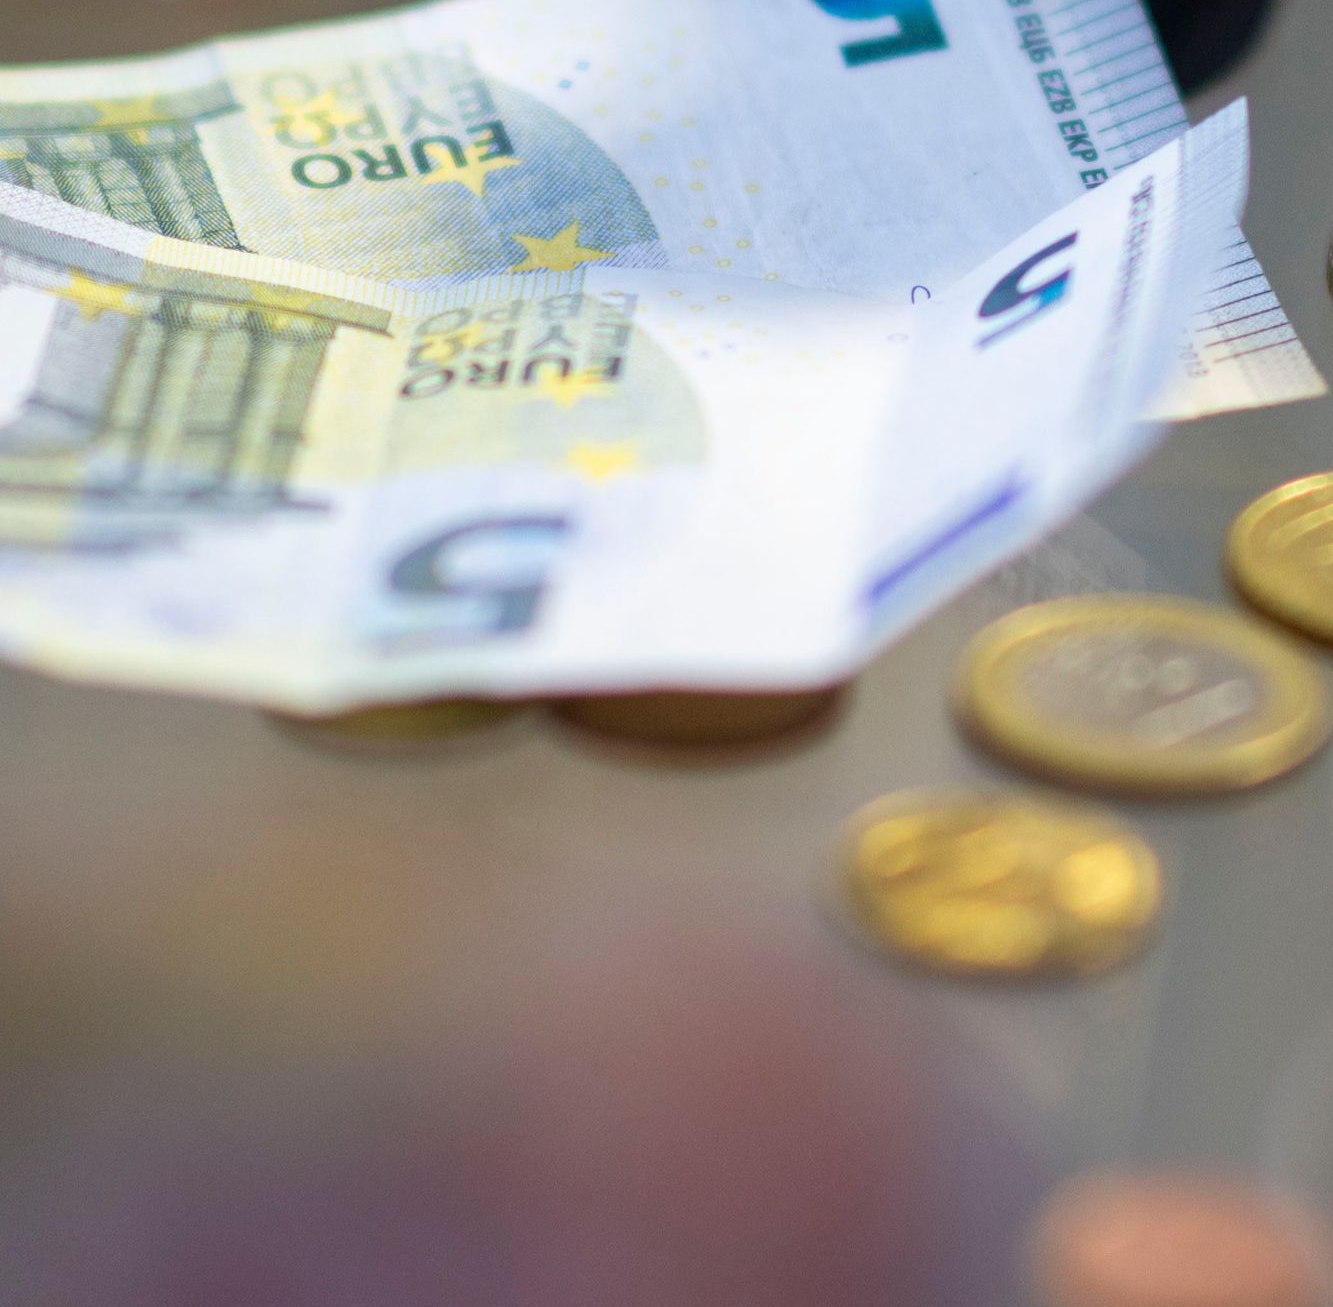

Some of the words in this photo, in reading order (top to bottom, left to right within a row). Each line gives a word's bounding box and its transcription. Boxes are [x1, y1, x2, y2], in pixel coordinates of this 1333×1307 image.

[291, 120, 514, 189] EURO
[1037, 68, 1077, 115] EZB
[1057, 118, 1099, 164] EKP
[974, 230, 1078, 350] 5
[397, 356, 623, 399] EURO
[373, 515, 570, 658] 5
